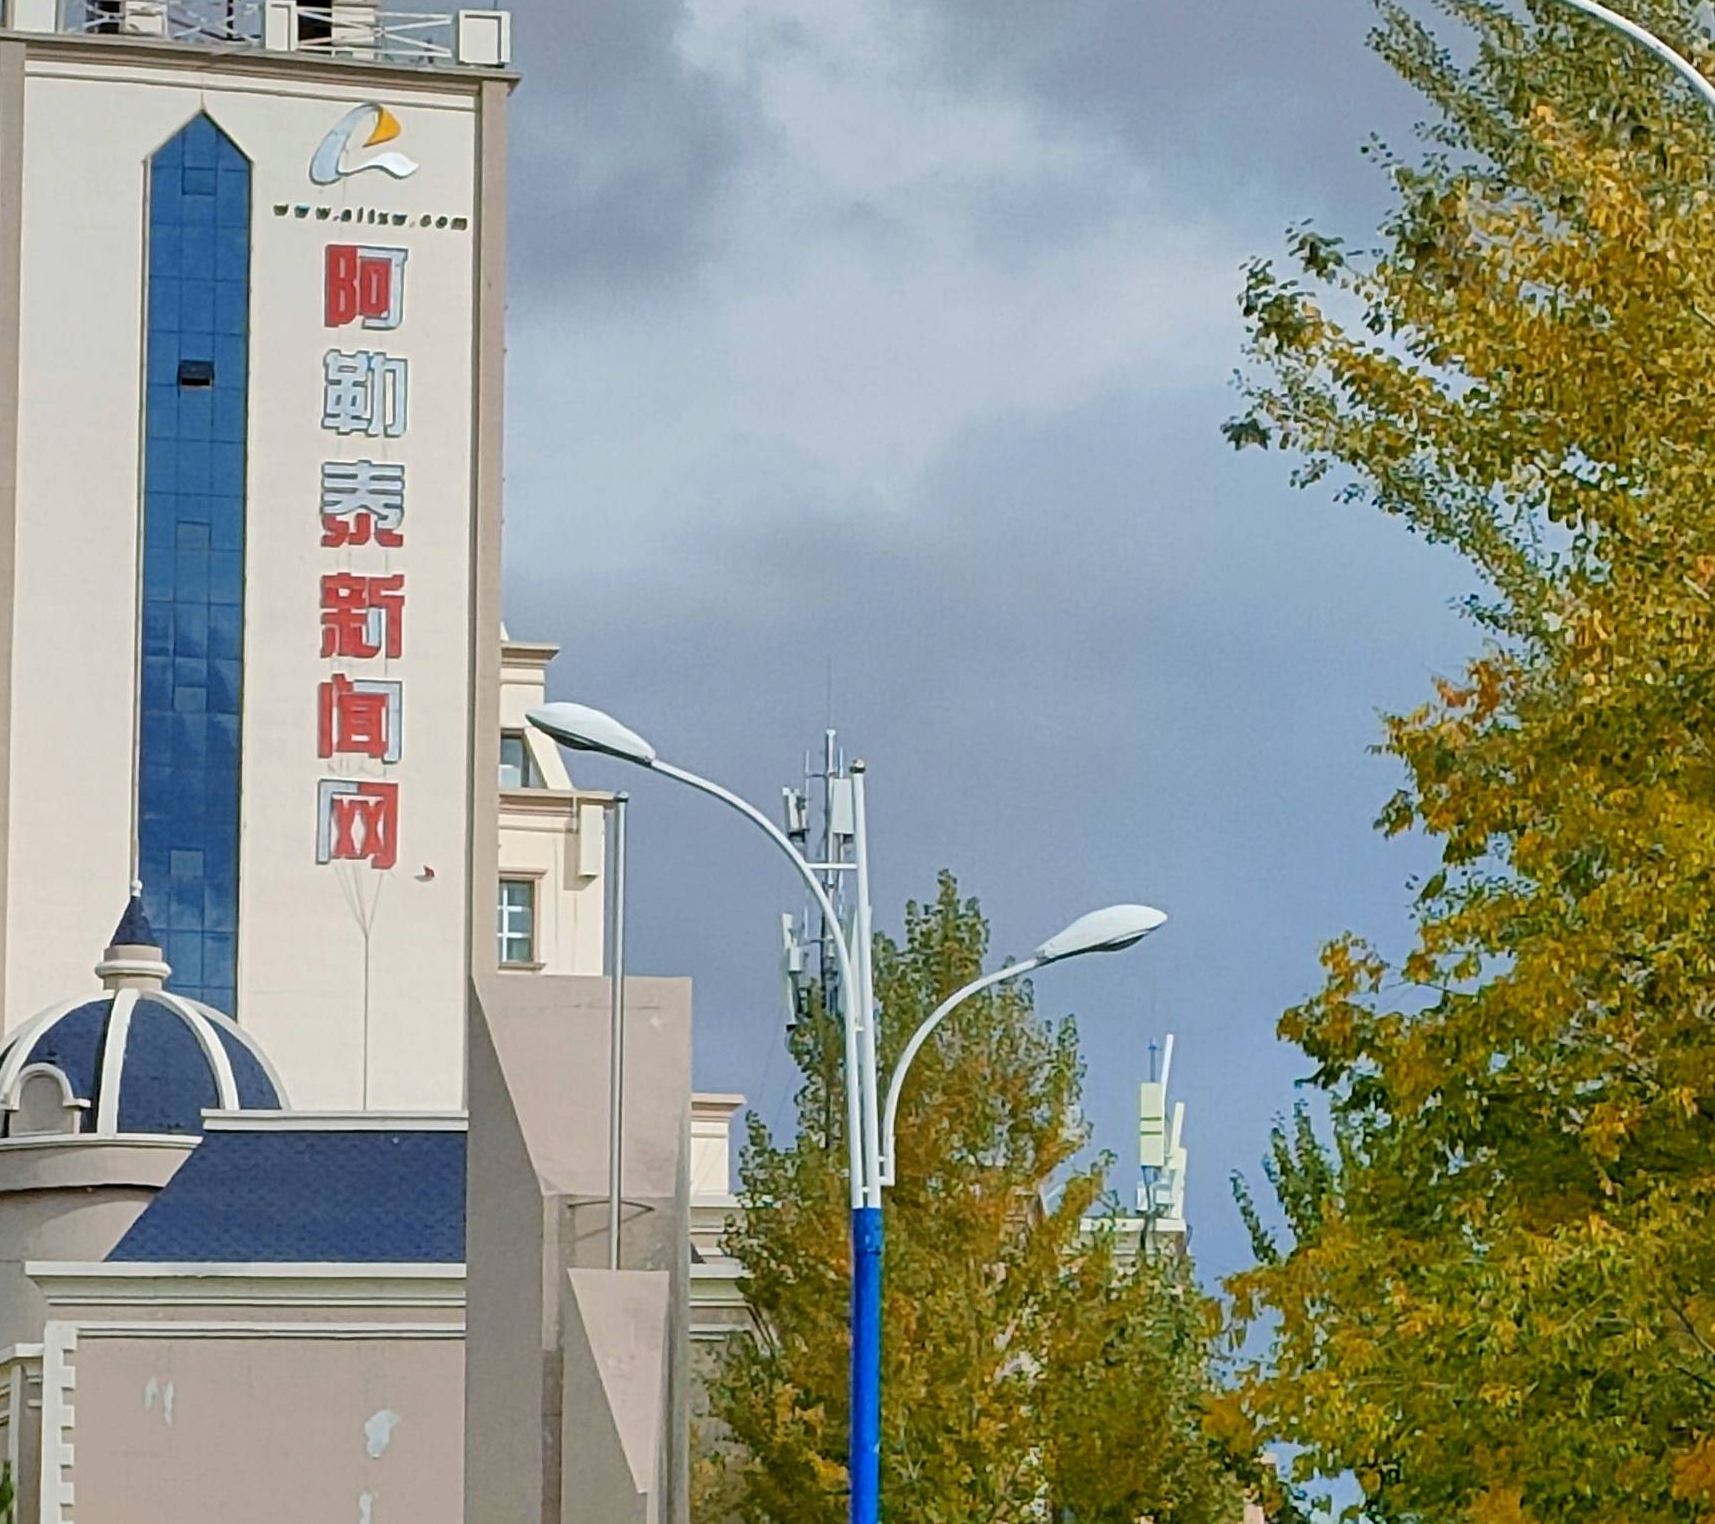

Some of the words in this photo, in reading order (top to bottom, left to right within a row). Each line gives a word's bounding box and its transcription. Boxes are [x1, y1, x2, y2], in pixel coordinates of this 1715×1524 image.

[315, 243, 409, 870] 阿勒泰新闻网
